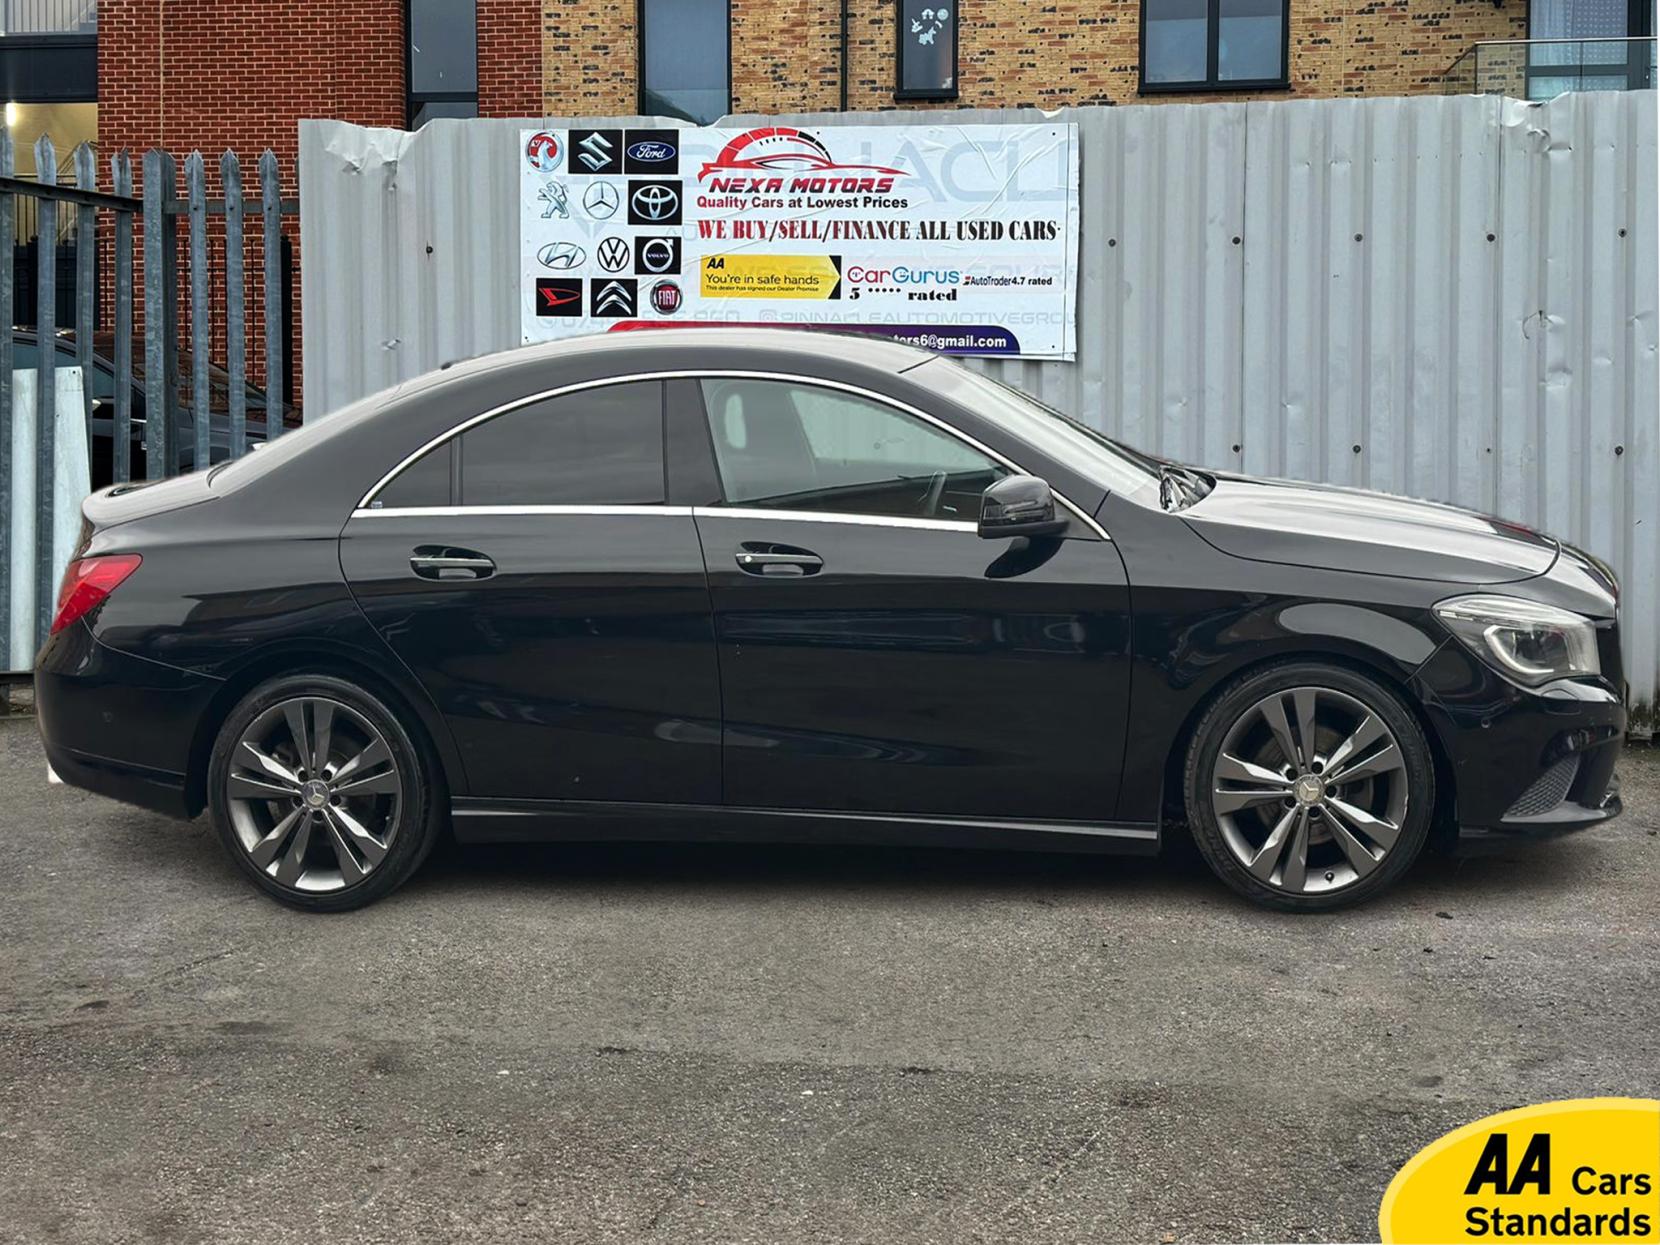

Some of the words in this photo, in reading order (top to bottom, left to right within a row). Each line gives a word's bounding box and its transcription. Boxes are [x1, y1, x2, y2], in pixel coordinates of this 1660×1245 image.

[637, 144, 666, 159] Ford
[709, 178, 784, 193] NEXA
[789, 178, 894, 193] MOTORS
[697, 196, 747, 210] Quality
[752, 196, 784, 208] Cars
[788, 197, 802, 208] at
[807, 196, 858, 208] Lowest
[863, 196, 908, 208] Prices
[697, 220, 727, 240] WE
[733, 220, 910, 242] BUY/SELL/FINANCE
[916, 220, 951, 240] ALL
[956, 220, 1004, 241] USED
[1009, 220, 1056, 241] CARS
[706, 257, 725, 269] AA
[706, 273, 741, 284] You're
[744, 274, 754, 284] in
[757, 274, 781, 285] safe
[784, 274, 820, 286] hands
[847, 266, 960, 284] CarGurus
[970, 276, 1011, 286] AutoTrader
[1011, 277, 1025, 286] 4.7
[1028, 277, 1053, 286] rated
[658, 290, 676, 306] FIAT
[849, 287, 860, 300] 5
[908, 288, 957, 301] rated
